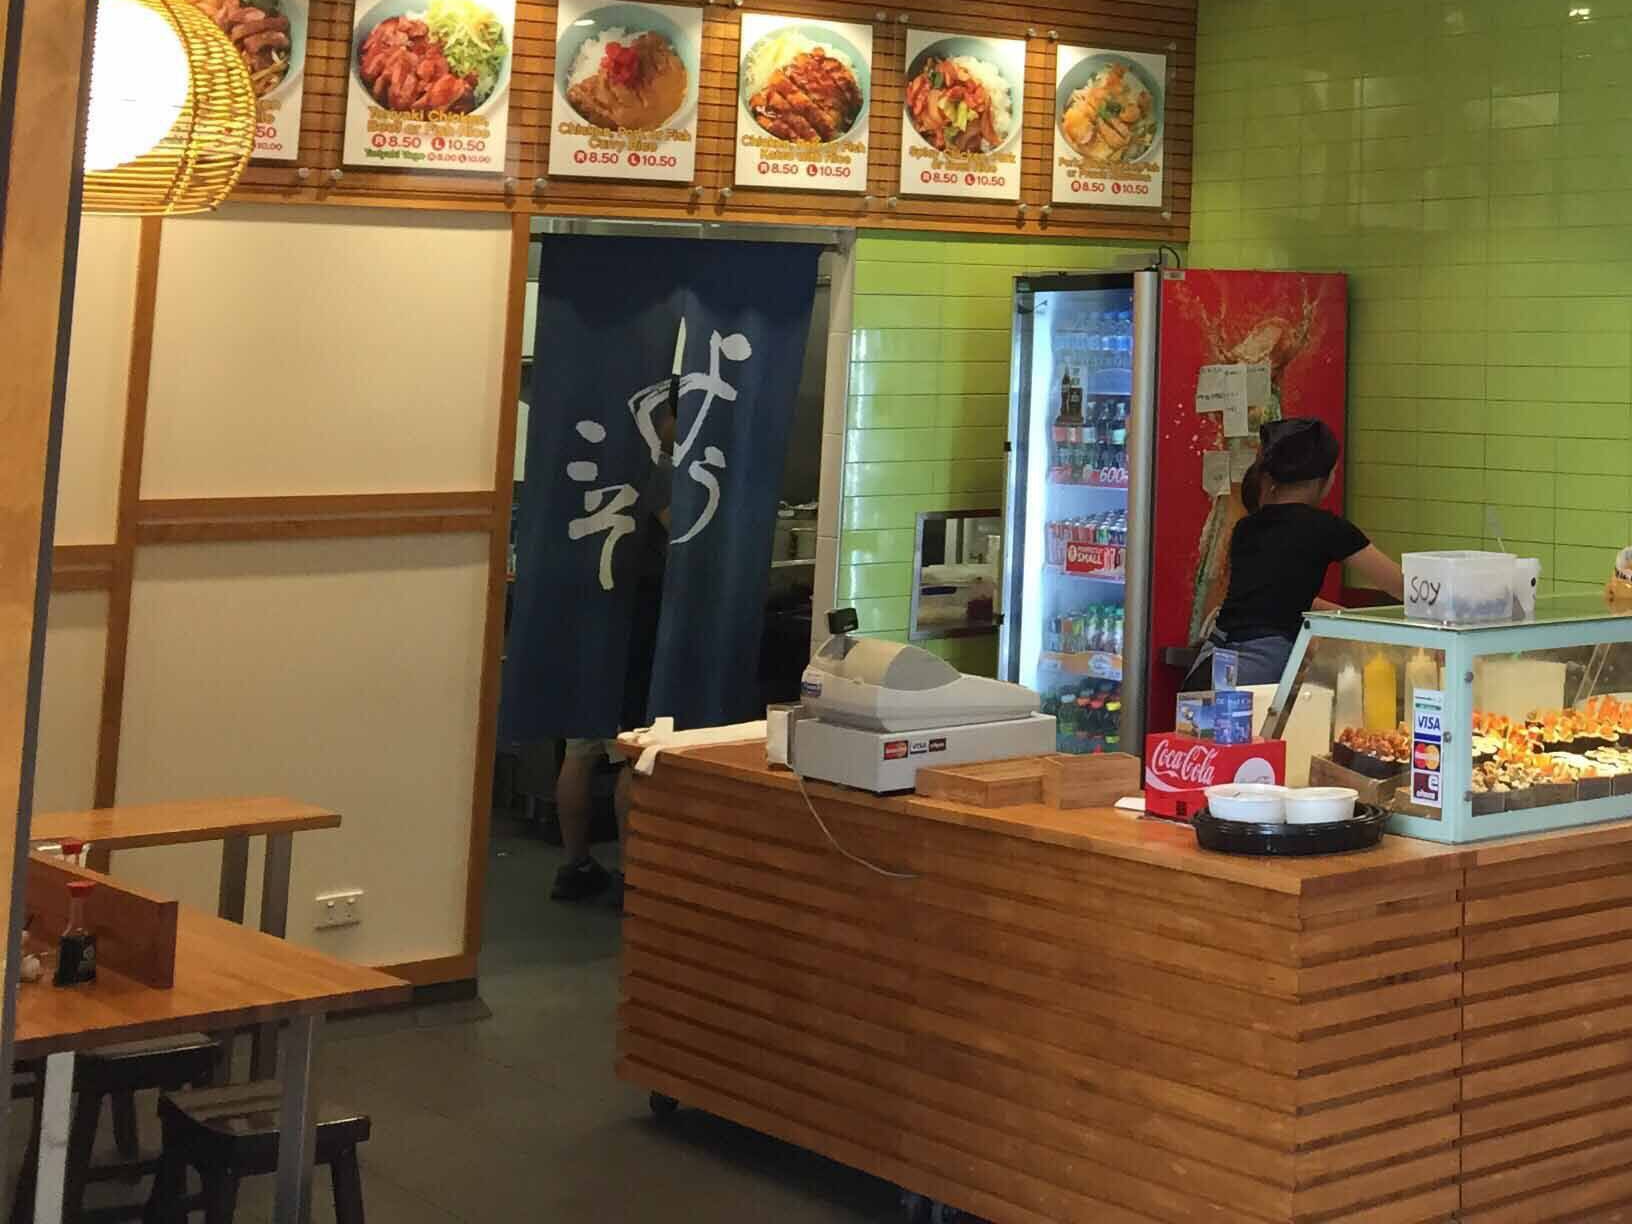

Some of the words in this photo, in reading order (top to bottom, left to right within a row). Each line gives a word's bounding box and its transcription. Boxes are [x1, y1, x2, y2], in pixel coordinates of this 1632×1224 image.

[388, 136, 422, 148] 8.50
[448, 139, 486, 151] 10.50
[589, 152, 619, 164] 8.50
[642, 155, 677, 167] 10.50
[771, 163, 799, 175] 8.50
[820, 166, 851, 177] 10.50
[933, 172, 958, 184] 8.50
[977, 175, 1005, 186] 10.50
[1082, 181, 1105, 192] 8.50
[1123, 183, 1149, 194] 10.50
[1418, 715, 1441, 730] VISA
[1152, 739, 1218, 785] Coca-Cola
